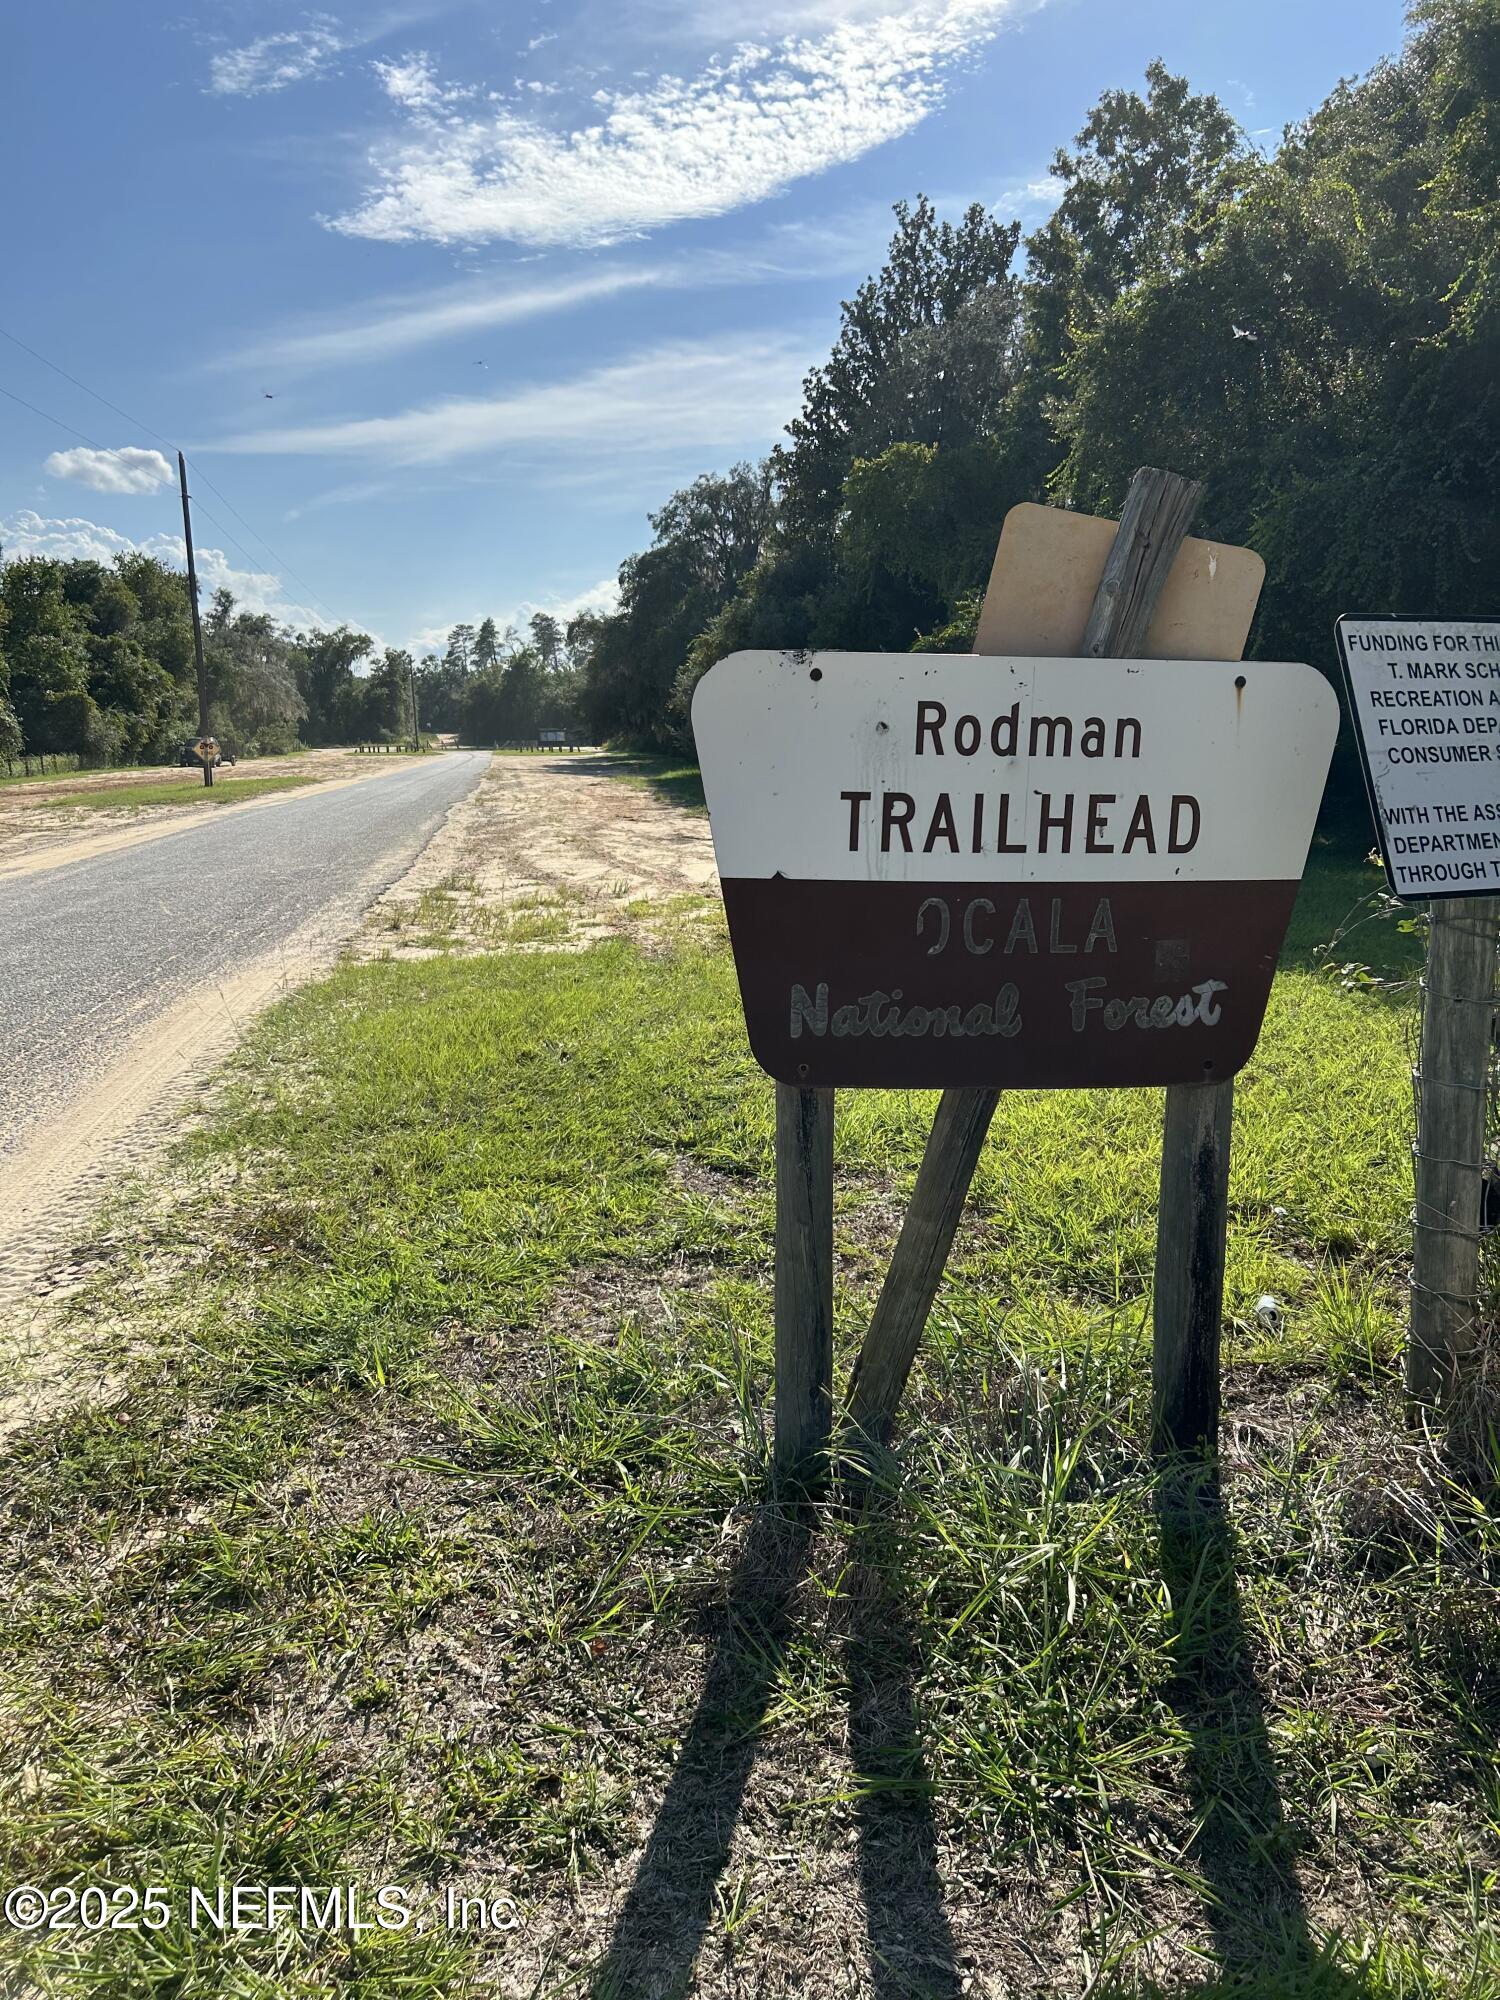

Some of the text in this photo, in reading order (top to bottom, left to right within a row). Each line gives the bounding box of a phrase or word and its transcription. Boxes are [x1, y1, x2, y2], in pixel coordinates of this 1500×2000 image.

[1348, 634, 1428, 651] FUNDING
[1433, 635, 1469, 651] FOR
[1388, 662, 1500, 679] T. MARK SCH
[1370, 690, 1483, 707] RECREATION
[915, 700, 1142, 758] Rodman
[1378, 717, 1500, 735] FLORIDA DEP
[1388, 745, 1492, 764] CONSUMER
[840, 791, 1200, 853] TRAILHEAD
[1384, 806, 1429, 825] WITH
[1433, 804, 1468, 823] THE
[1396, 861, 1486, 883] THROUGH
[790, 976, 1228, 1038] National Forest
